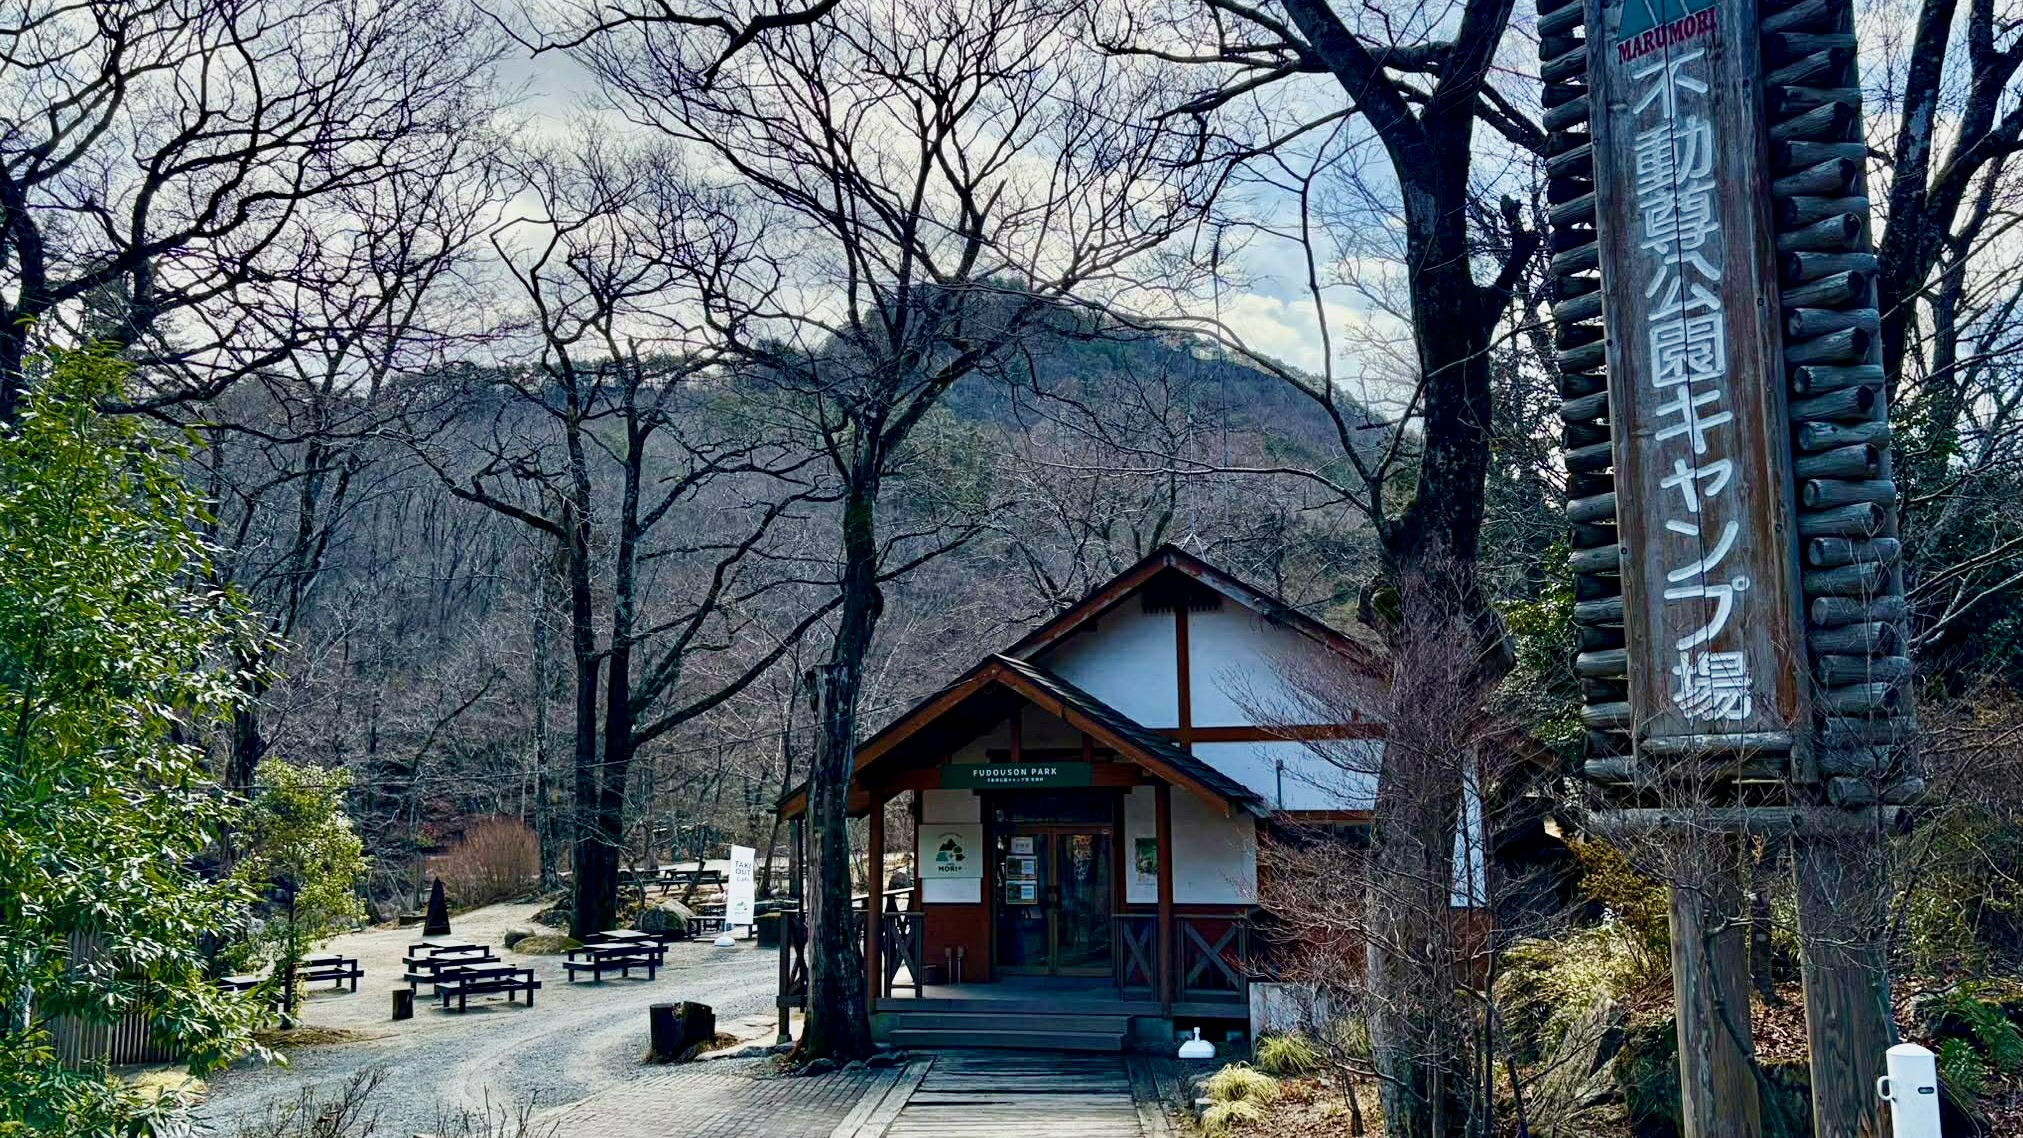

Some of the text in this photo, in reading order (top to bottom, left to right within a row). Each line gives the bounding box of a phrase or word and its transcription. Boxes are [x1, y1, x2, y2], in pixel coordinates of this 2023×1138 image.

[1618, 6, 1717, 64] MARUMORI
[1632, 48, 1752, 721] 不動尊公園キャンプ場
[973, 768, 1027, 776] FUDOUSON
[735, 868, 750, 876] OUT
